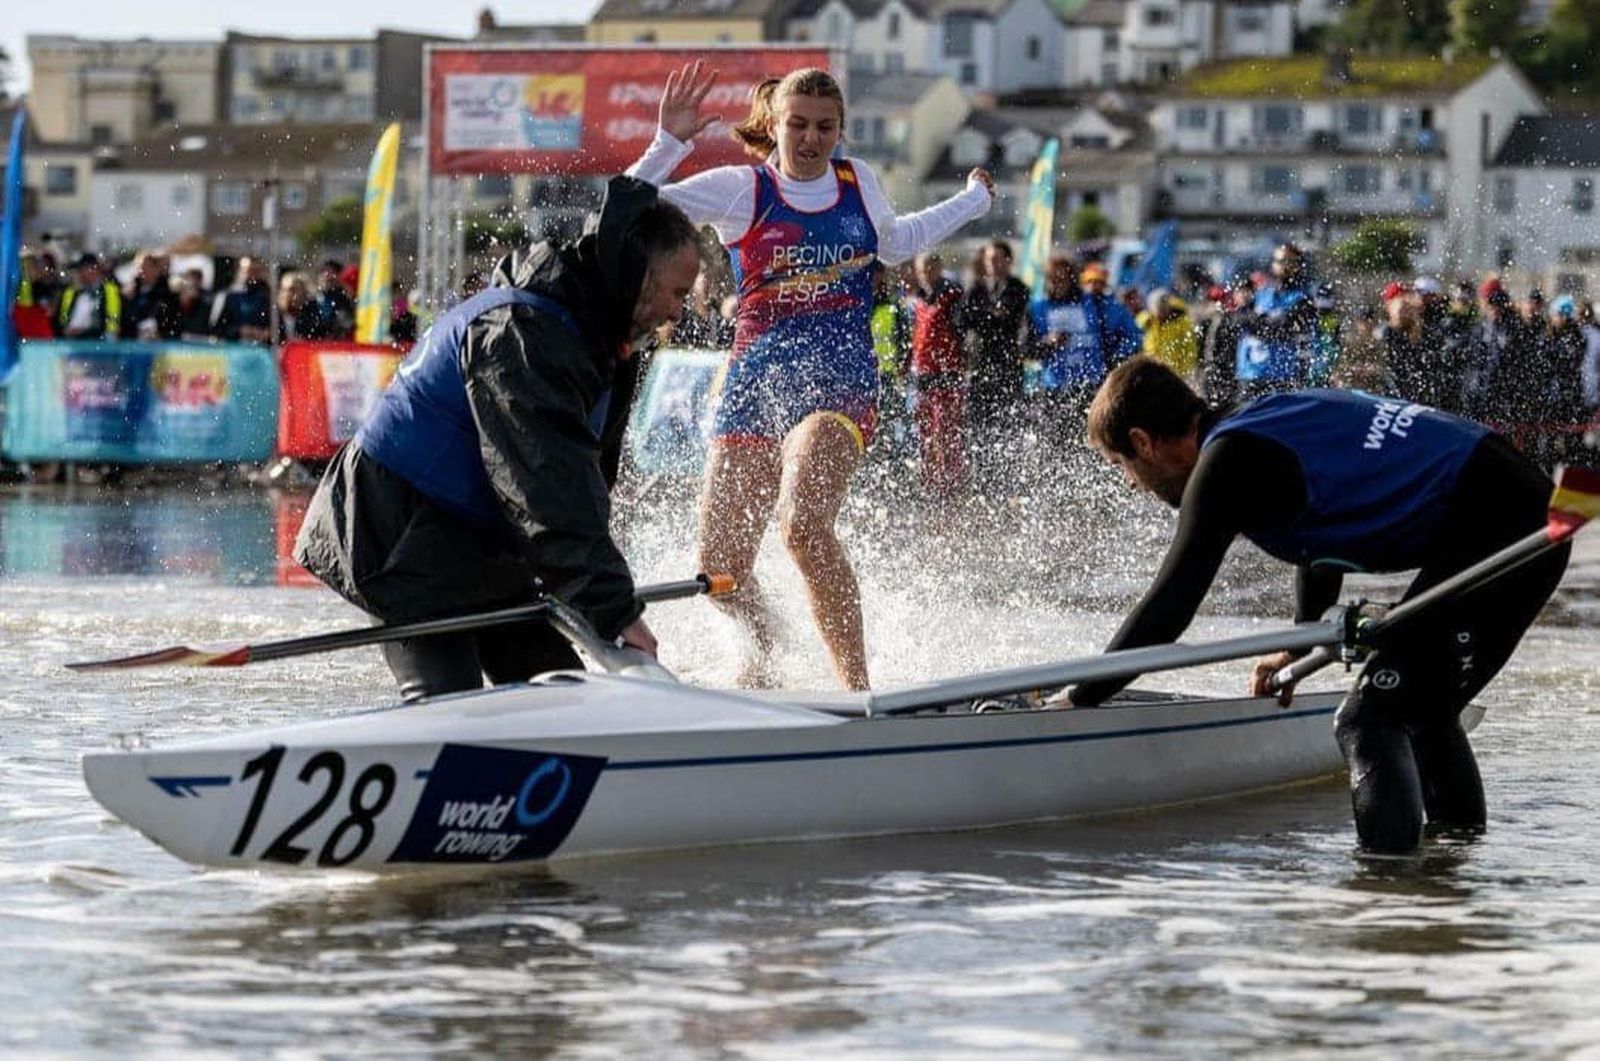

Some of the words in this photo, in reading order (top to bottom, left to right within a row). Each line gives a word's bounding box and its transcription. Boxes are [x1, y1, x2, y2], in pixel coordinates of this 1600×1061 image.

[773, 244, 855, 268] PECINO
[778, 281, 830, 303] ESP
[230, 744, 397, 868] 128
[438, 795, 517, 829] world
[434, 831, 524, 861] rowing
